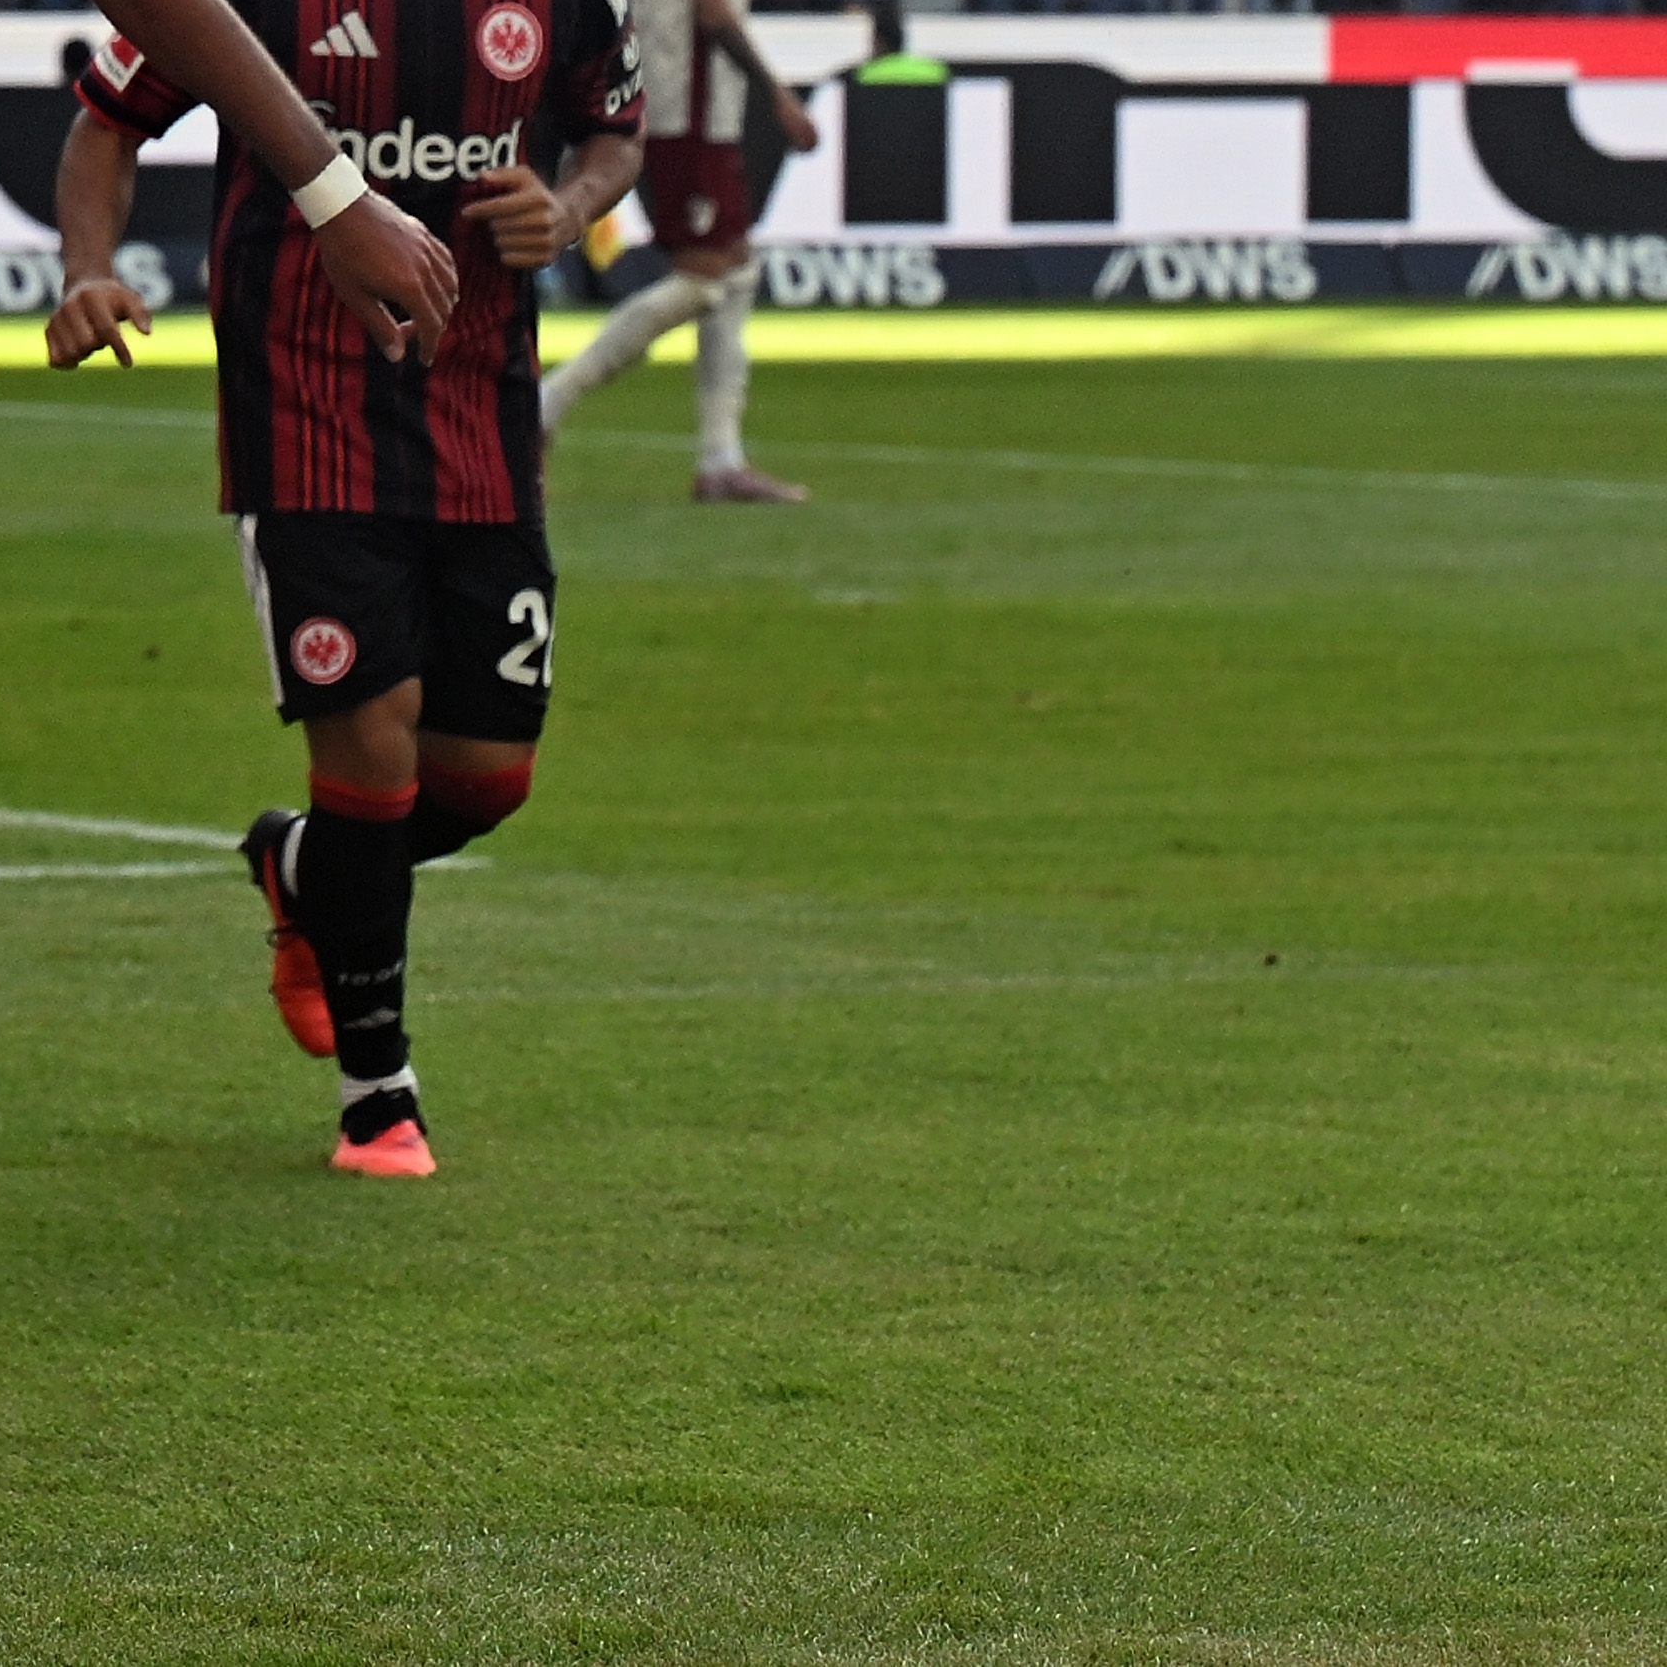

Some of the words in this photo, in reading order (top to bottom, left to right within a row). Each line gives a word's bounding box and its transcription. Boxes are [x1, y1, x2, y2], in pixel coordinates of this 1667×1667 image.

[327, 115, 523, 182] ndeed
[766, 243, 947, 308] DWS
[1142, 238, 1317, 302] DWS
[1512, 233, 1667, 300] DWS
